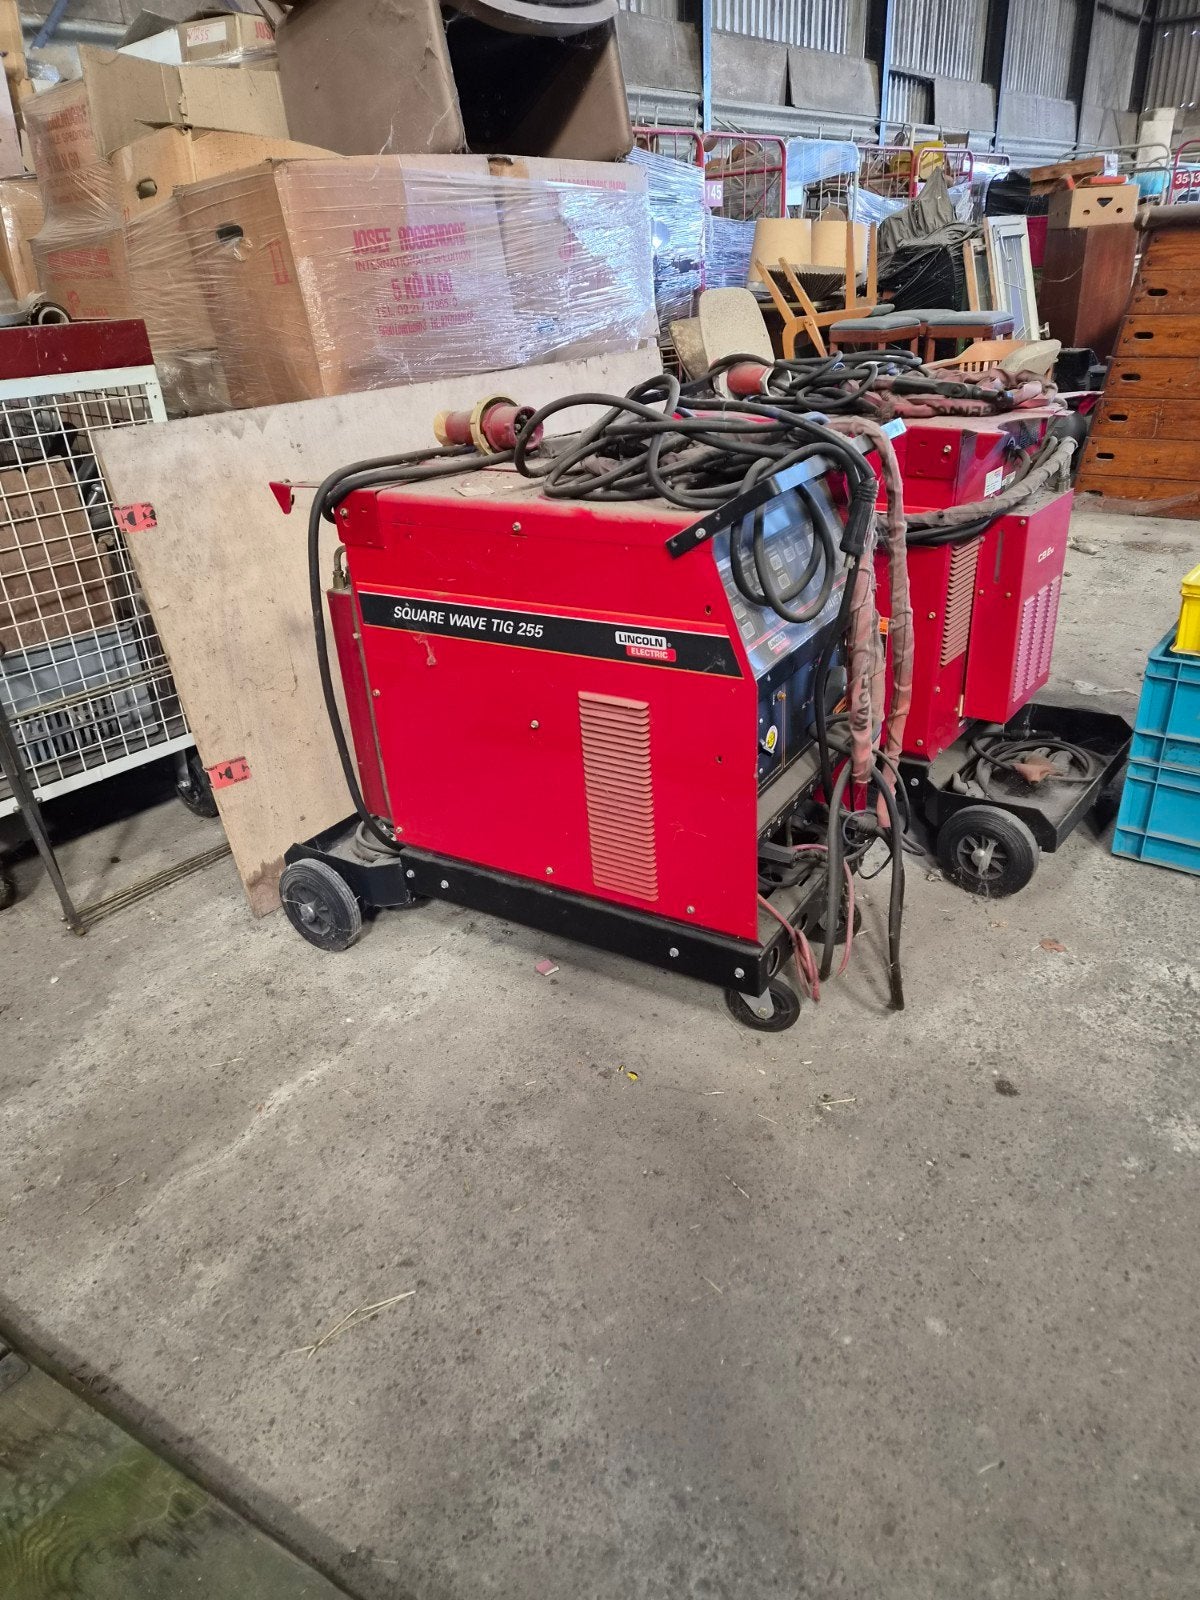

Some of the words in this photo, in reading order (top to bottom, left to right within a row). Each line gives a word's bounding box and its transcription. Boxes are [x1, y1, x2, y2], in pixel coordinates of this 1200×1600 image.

[255, 21, 275, 40] JOS
[353, 227, 391, 255] JOSEF
[403, 271, 437, 299] KÖLN
[393, 605, 445, 625] SQUARE
[449, 613, 487, 630] WAVE
[491, 618, 514, 634] TIG
[517, 622, 544, 638] 255
[618, 633, 663, 648] LINCOLN
[630, 646, 668, 659] ELECTRIC
